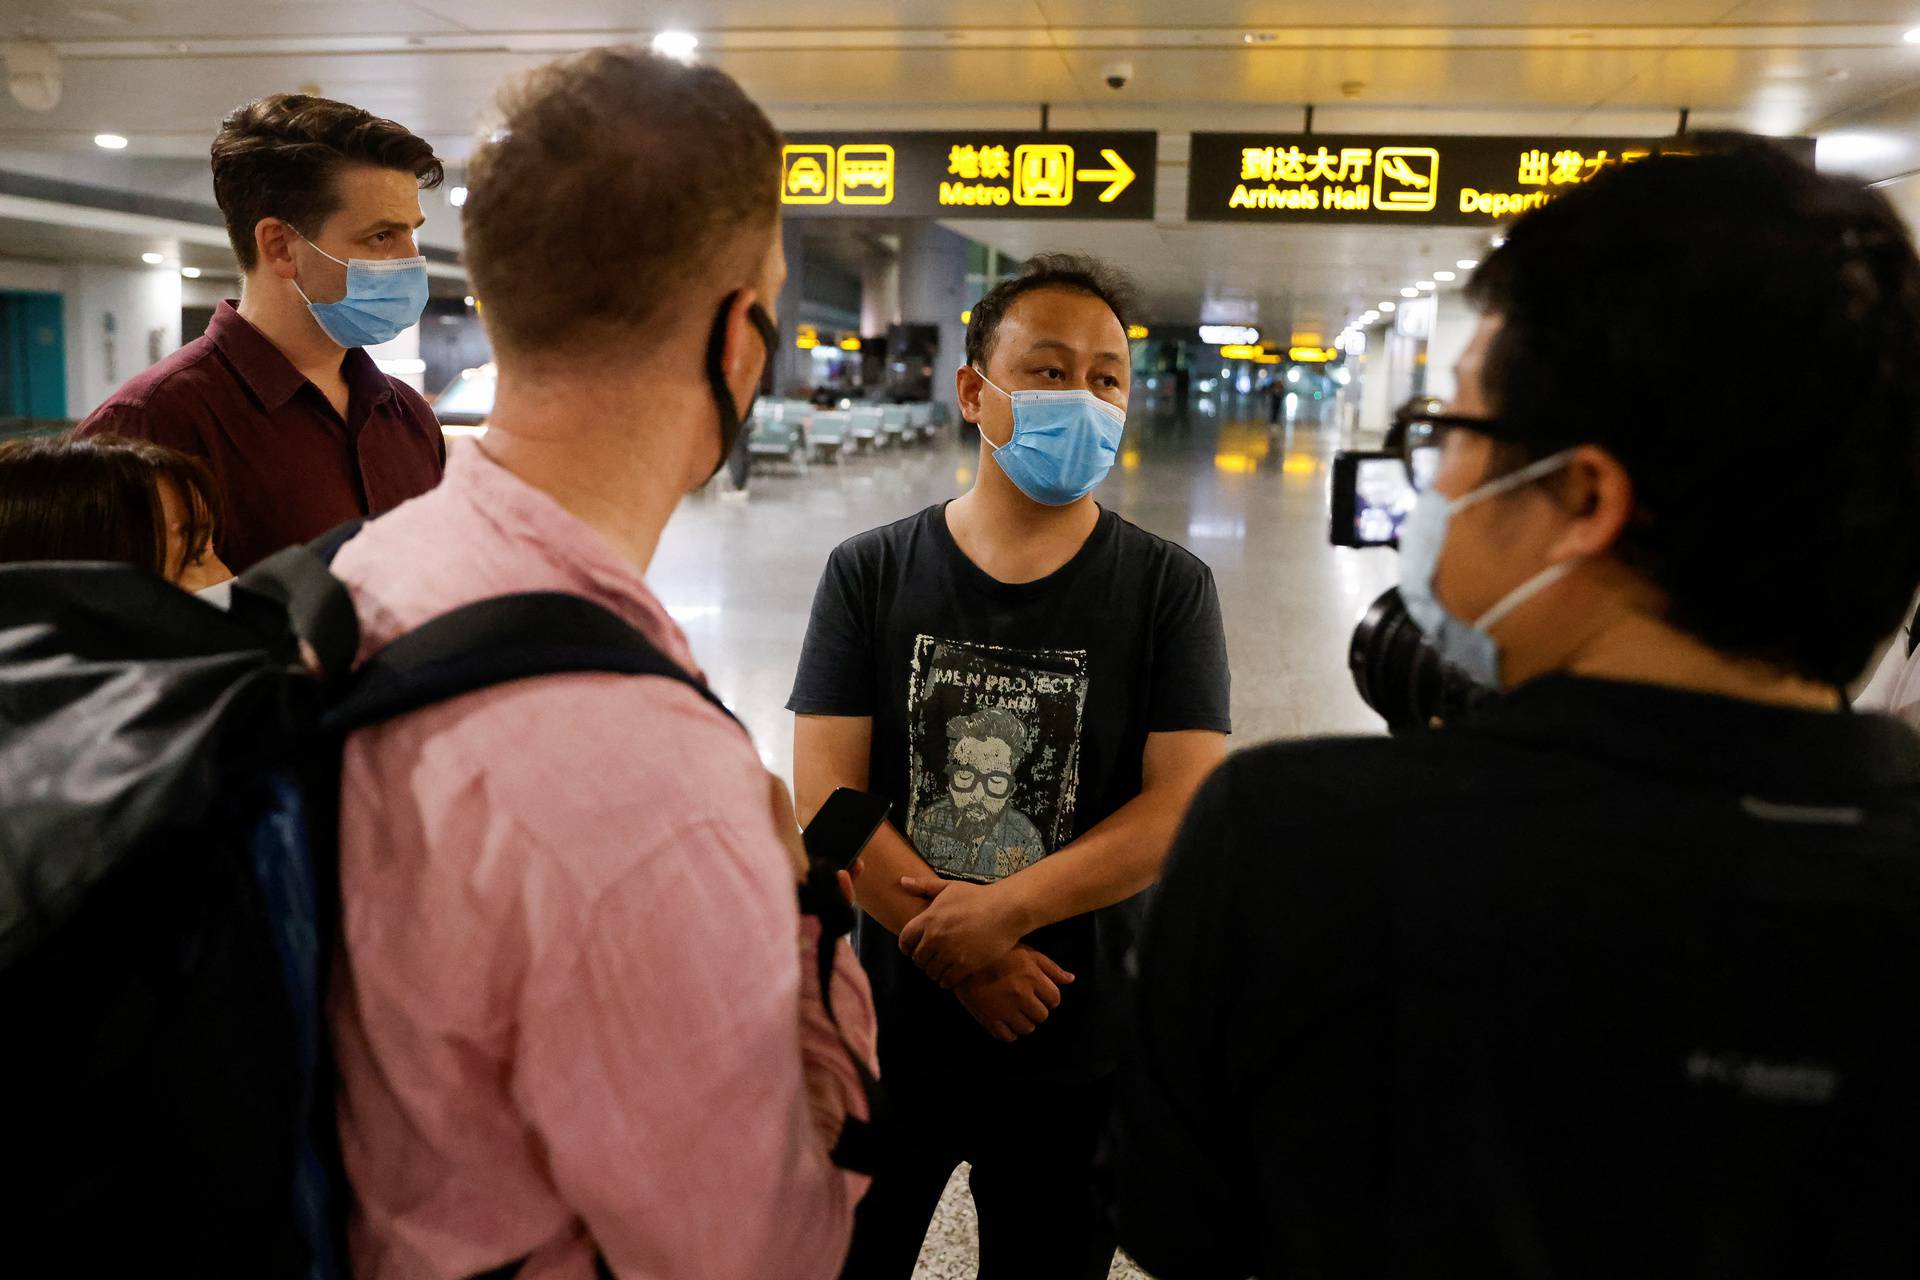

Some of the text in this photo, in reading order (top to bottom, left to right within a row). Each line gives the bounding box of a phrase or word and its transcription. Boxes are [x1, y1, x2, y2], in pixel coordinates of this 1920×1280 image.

[947, 144, 1011, 179] 地铁
[1240, 145, 1372, 182] 到达大厅
[939, 181, 1011, 206] Metro
[1229, 184, 1371, 210] Arrivals Hall
